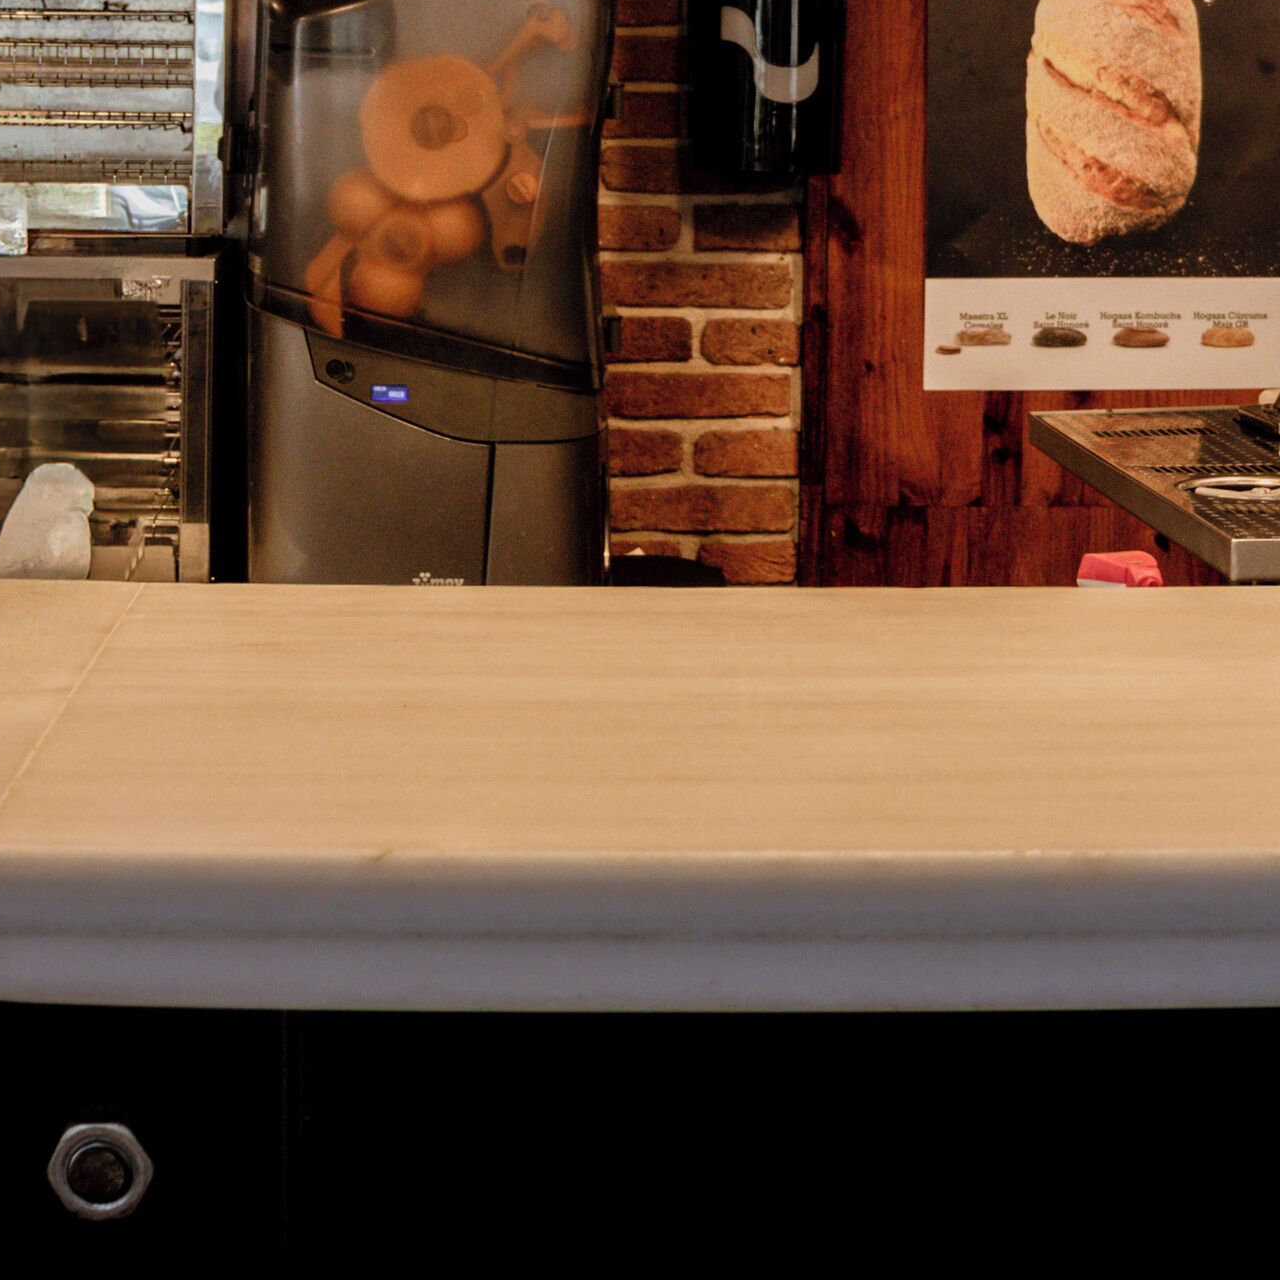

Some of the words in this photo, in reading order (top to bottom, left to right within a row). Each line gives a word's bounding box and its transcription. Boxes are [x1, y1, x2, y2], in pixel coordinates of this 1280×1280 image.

[996, 312, 1009, 320] XL
[1056, 312, 1078, 321] Noir
[1130, 311, 1182, 321] Kombucha
